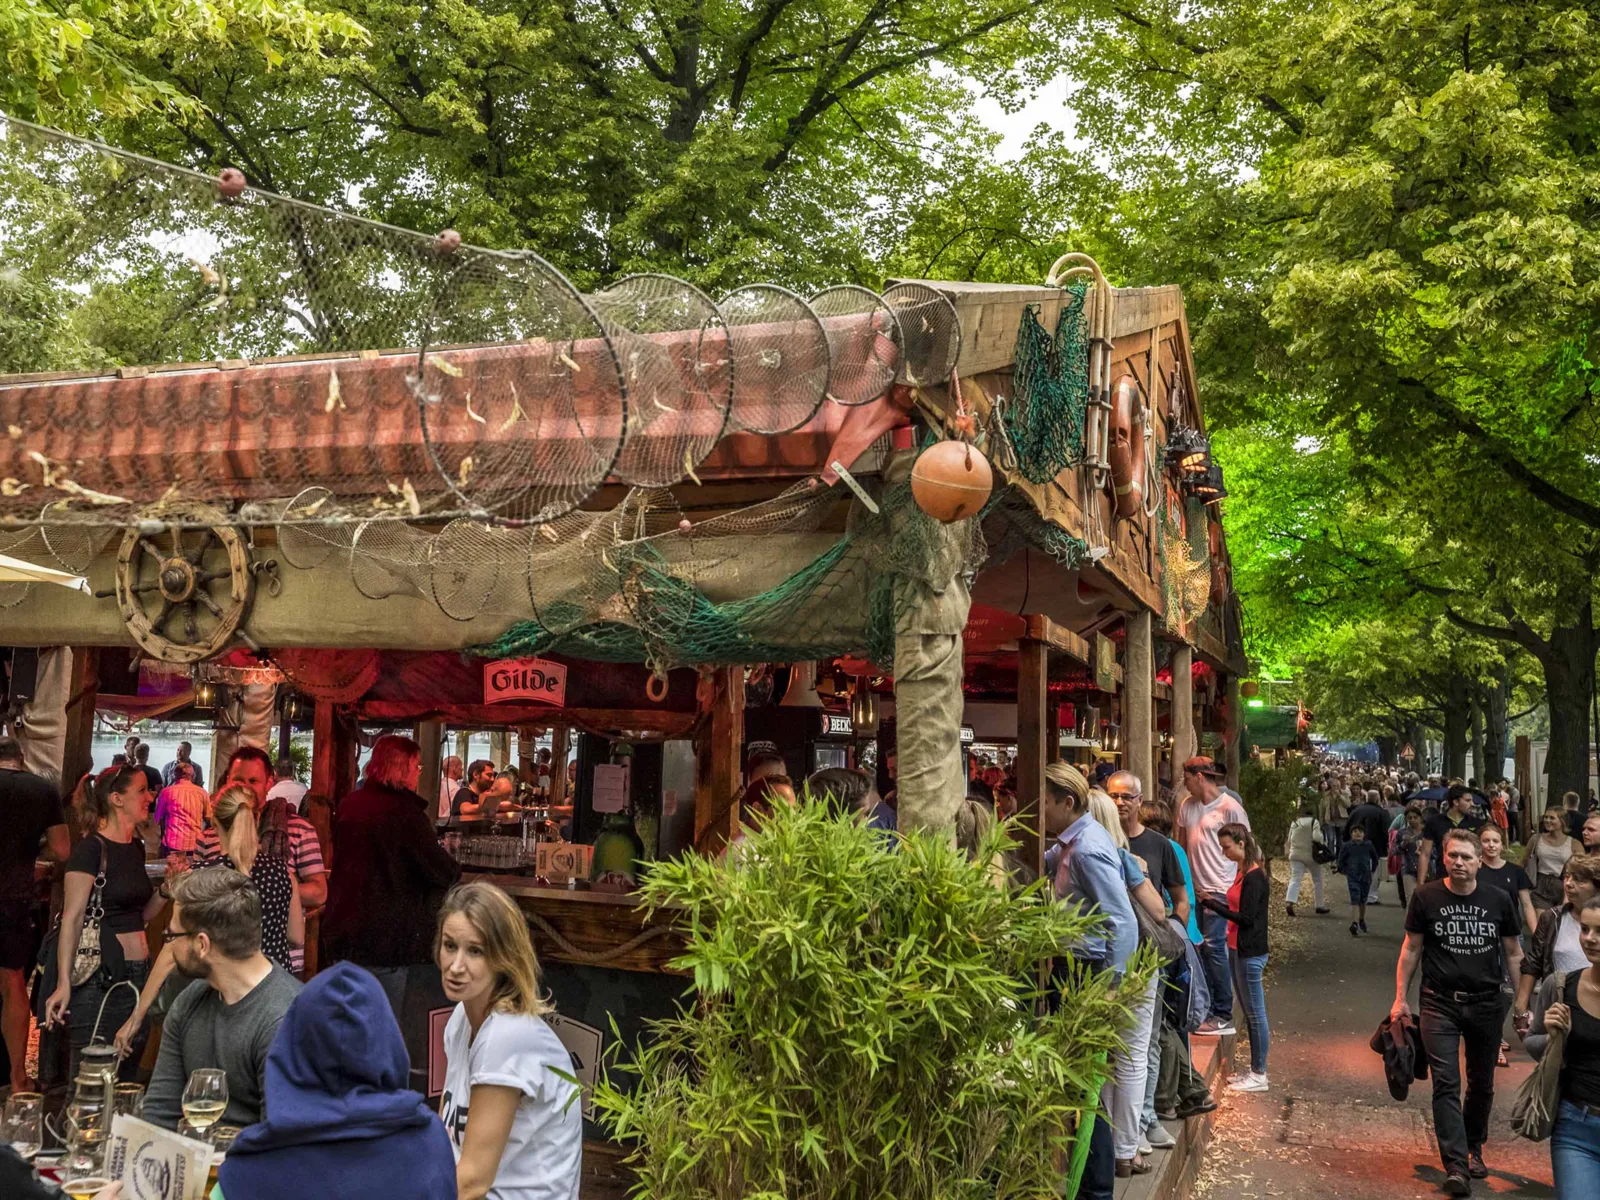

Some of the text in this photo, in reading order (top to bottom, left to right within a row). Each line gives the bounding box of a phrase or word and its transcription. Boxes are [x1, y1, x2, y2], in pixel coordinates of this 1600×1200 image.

[491, 668, 559, 692] Gilde
[1440, 904, 1488, 917] QUALITY
[1434, 920, 1497, 938] S.OLIVER
[1448, 936, 1485, 946] BRAND
[1440, 943, 1494, 955] AUTHENTIC CASUAL
